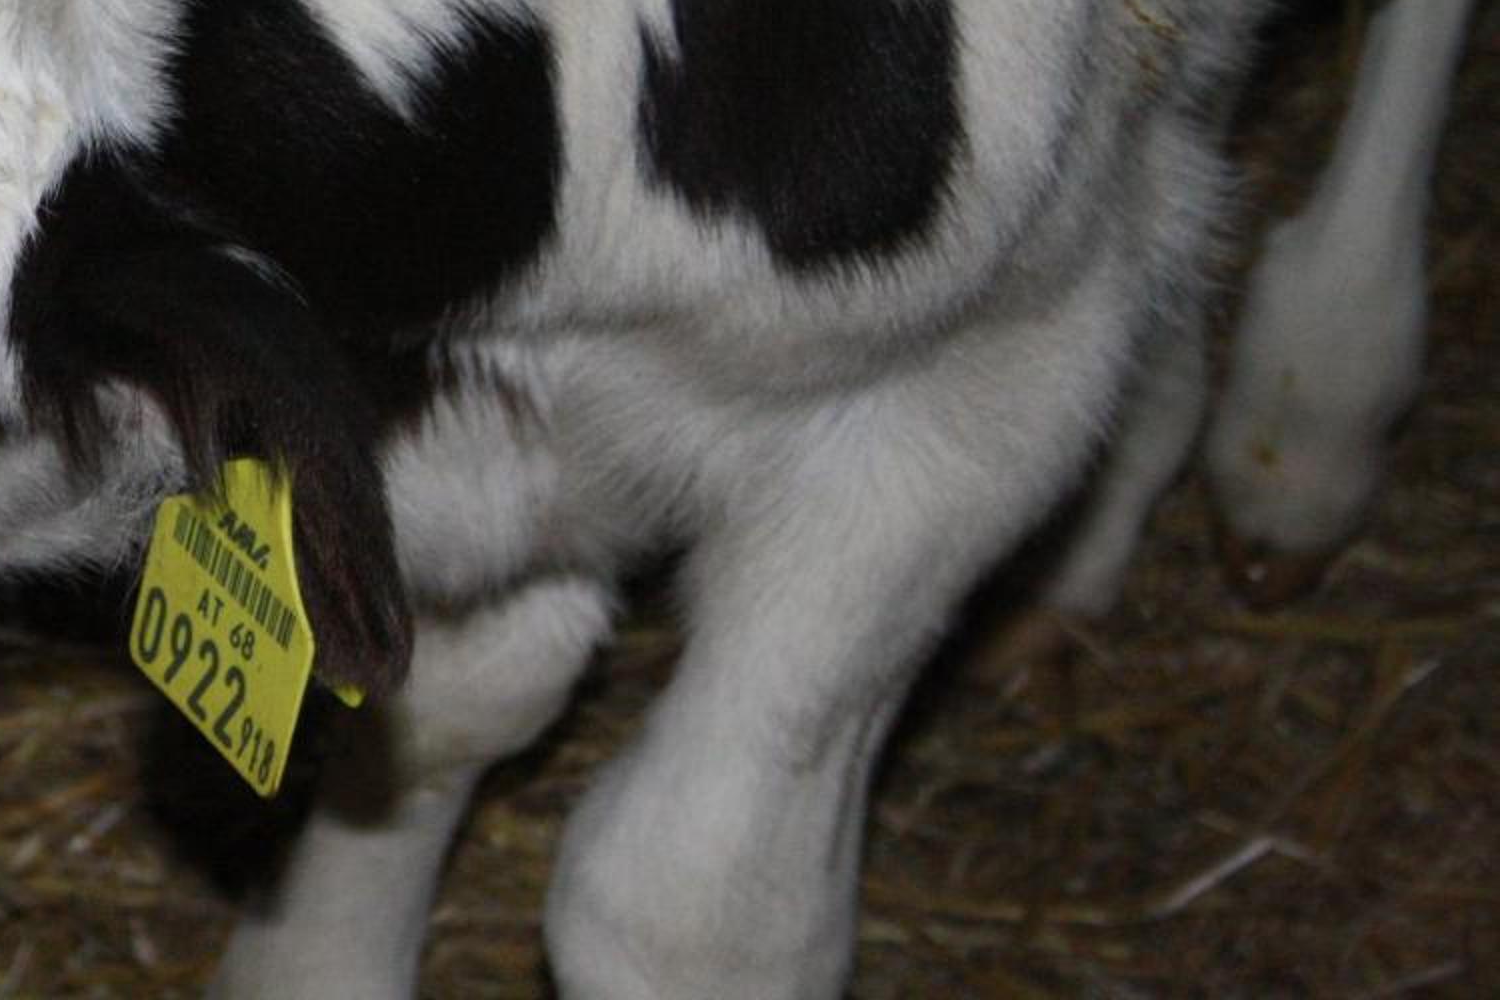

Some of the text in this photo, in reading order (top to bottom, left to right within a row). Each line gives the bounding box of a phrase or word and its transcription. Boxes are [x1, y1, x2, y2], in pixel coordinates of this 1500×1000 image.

[138, 587, 275, 785] 0922 918
[197, 589, 255, 661] AT 68
